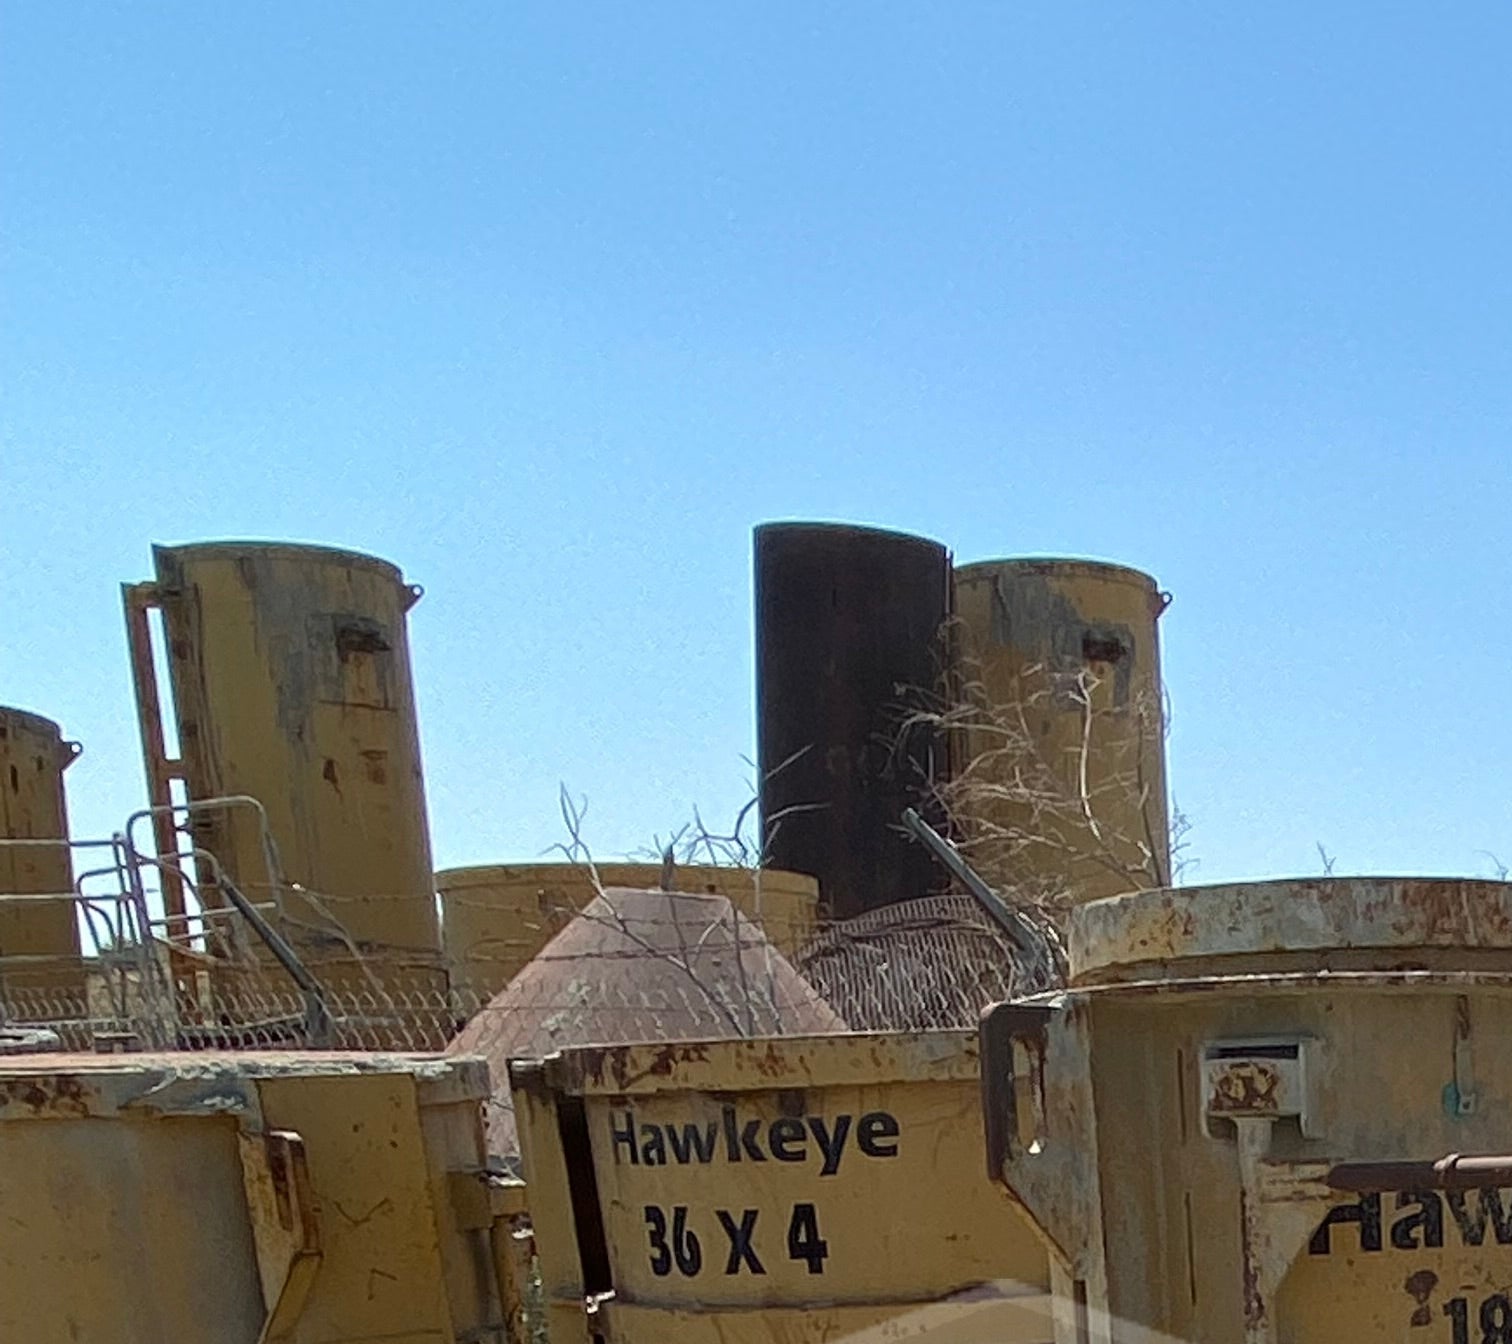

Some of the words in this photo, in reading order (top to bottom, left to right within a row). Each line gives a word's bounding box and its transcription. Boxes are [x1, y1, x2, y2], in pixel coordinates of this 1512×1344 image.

[609, 1102, 900, 1177] Hawkeye
[644, 1205, 702, 1276] 36
[788, 1203, 829, 1275] 4
